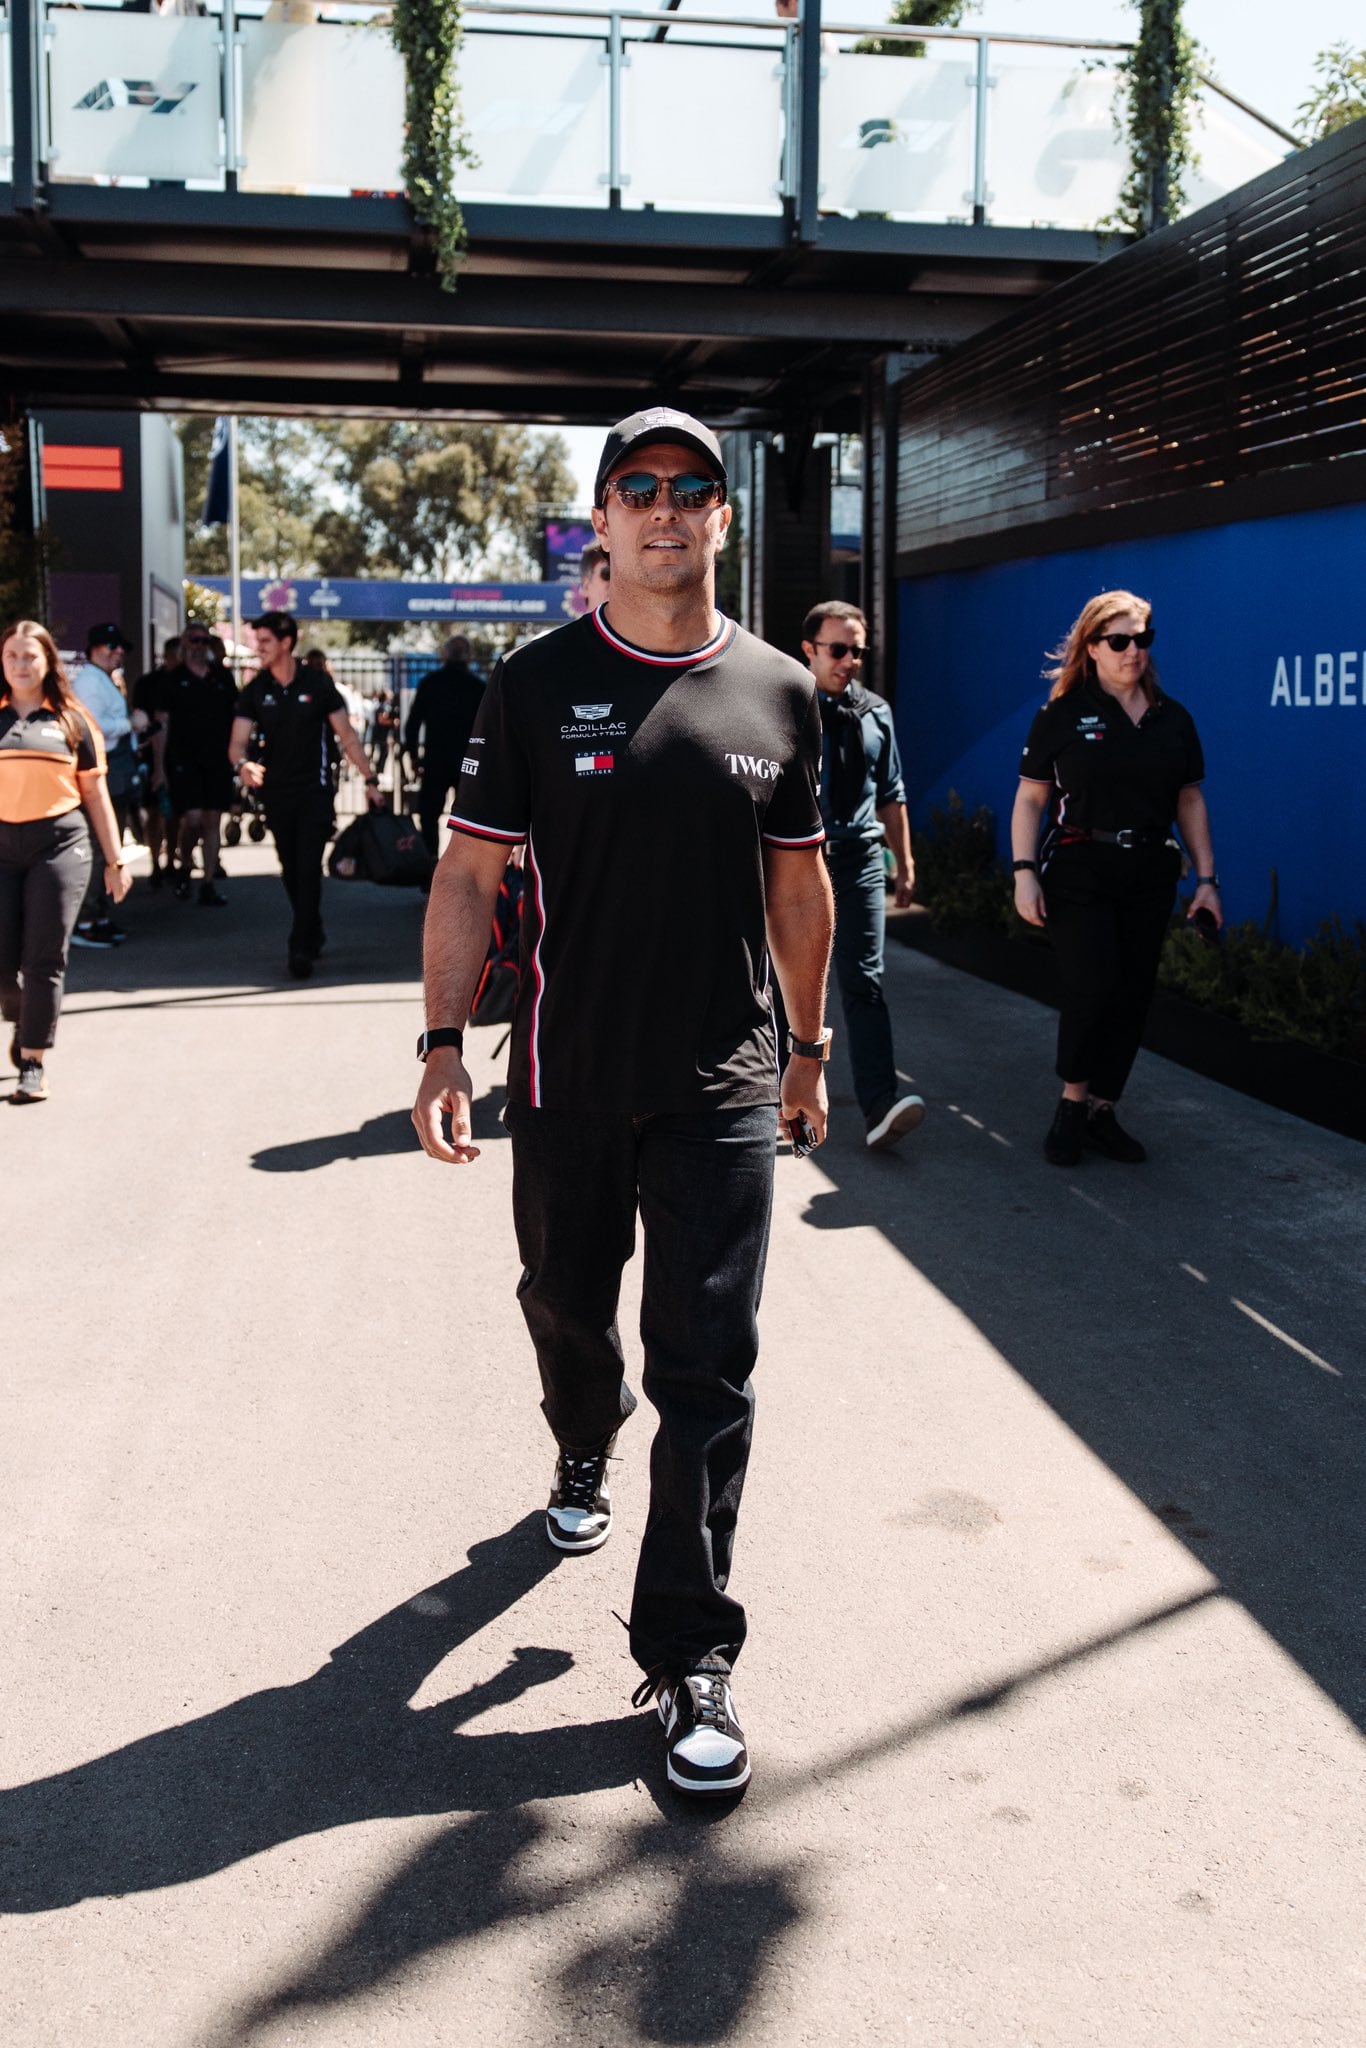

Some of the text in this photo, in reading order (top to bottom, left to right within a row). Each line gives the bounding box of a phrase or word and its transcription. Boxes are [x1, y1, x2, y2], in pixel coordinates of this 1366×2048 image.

[1270, 650, 1366, 707] ALBE
[560, 722, 627, 733] CADILLAC
[561, 732, 597, 740] FORMULA
[725, 753, 769, 779] TWG
[577, 769, 612, 777] HILFIGER
